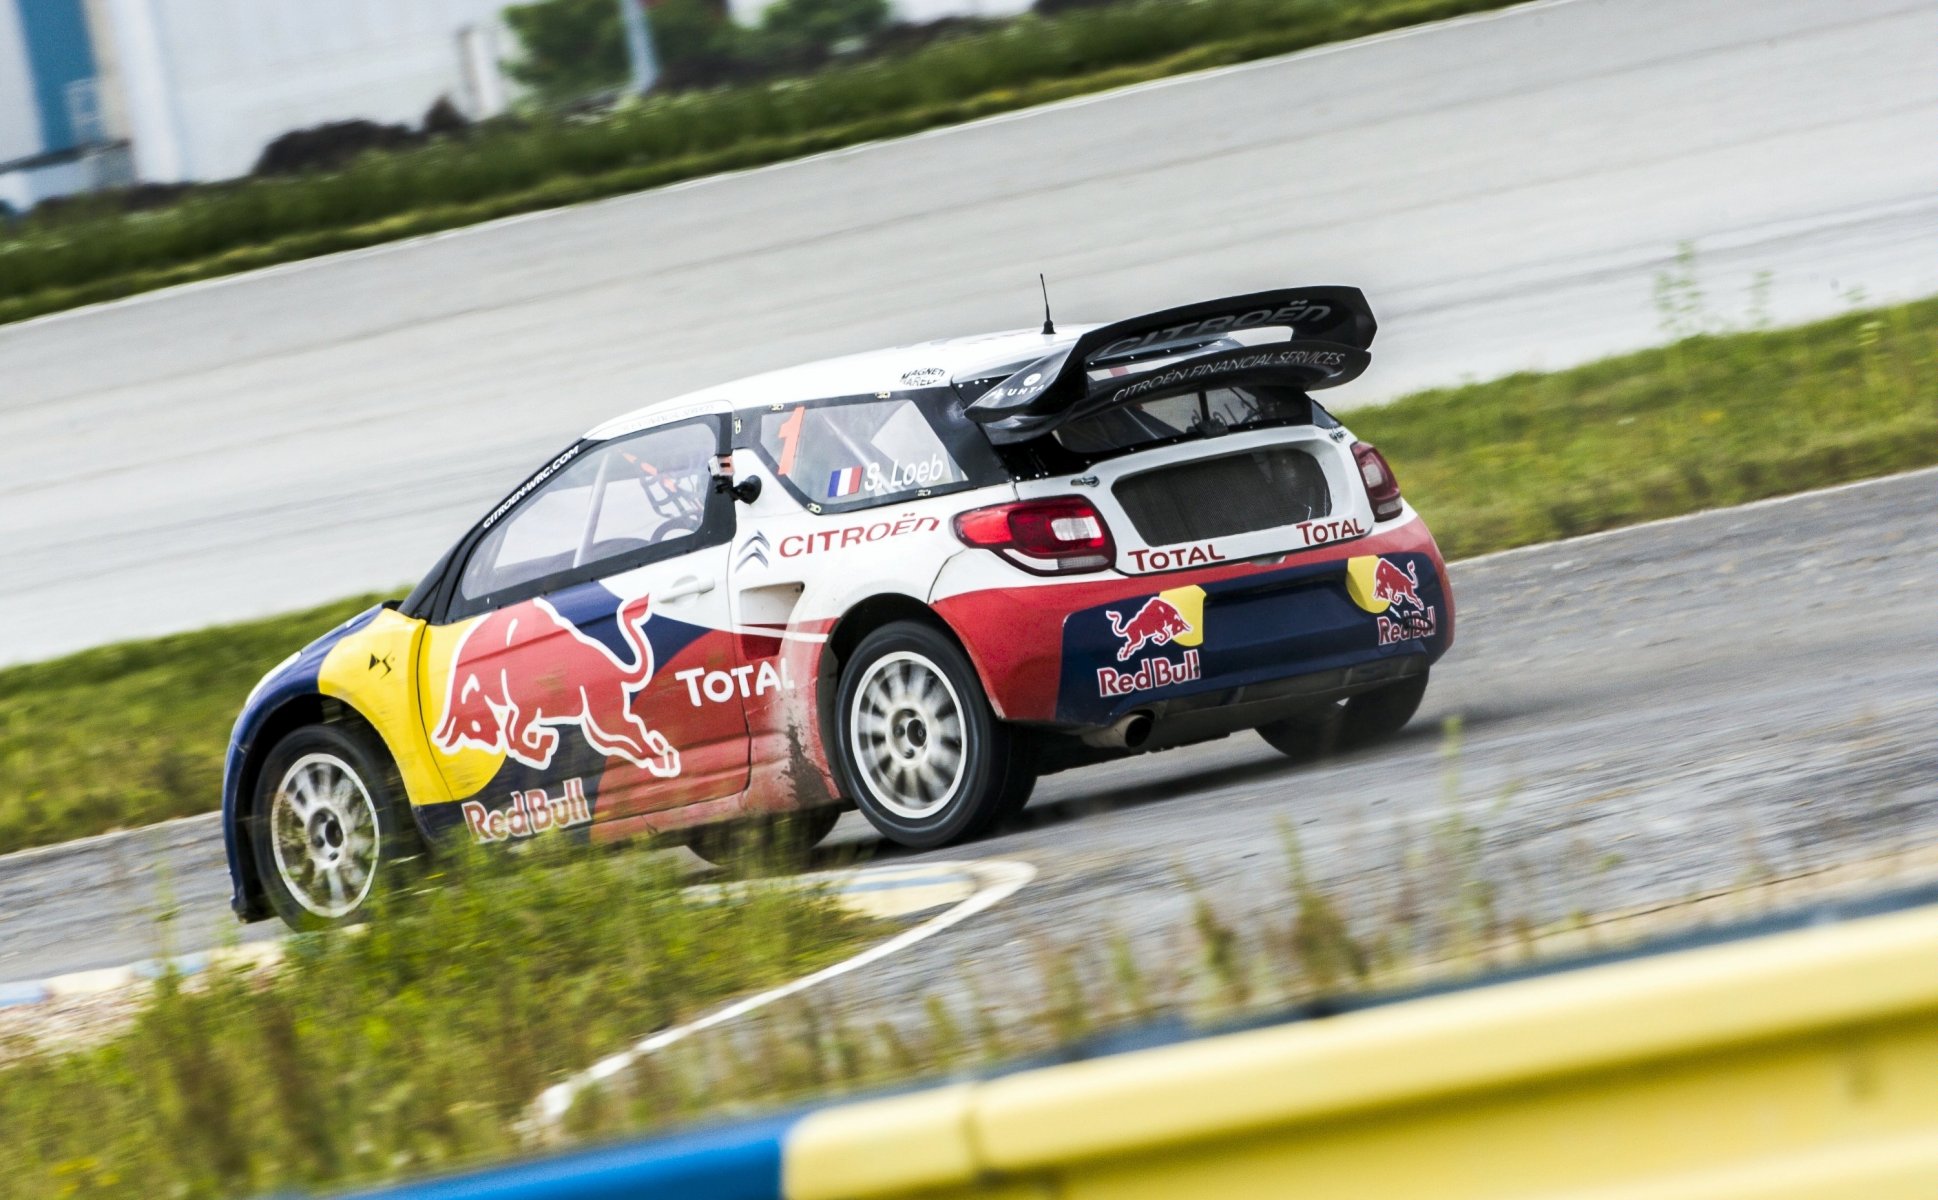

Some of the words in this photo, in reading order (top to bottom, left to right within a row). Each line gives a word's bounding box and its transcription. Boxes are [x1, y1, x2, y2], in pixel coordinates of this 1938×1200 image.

[1190, 354, 1273, 378] FINANCIAL
[1274, 350, 1346, 366] SERVICES
[777, 406, 805, 476] 1
[483, 445, 579, 528] CITROEN-WRC.COM
[864, 462, 883, 491] S.
[891, 453, 944, 487] Loeb
[1296, 518, 1365, 545] TOTAL
[1128, 544, 1226, 571] TOTAL
[674, 657, 795, 707] TOTAL
[1097, 658, 1153, 697] Red
[1152, 649, 1201, 688] Bull
[462, 790, 533, 845] Red
[525, 777, 592, 834] Bull
